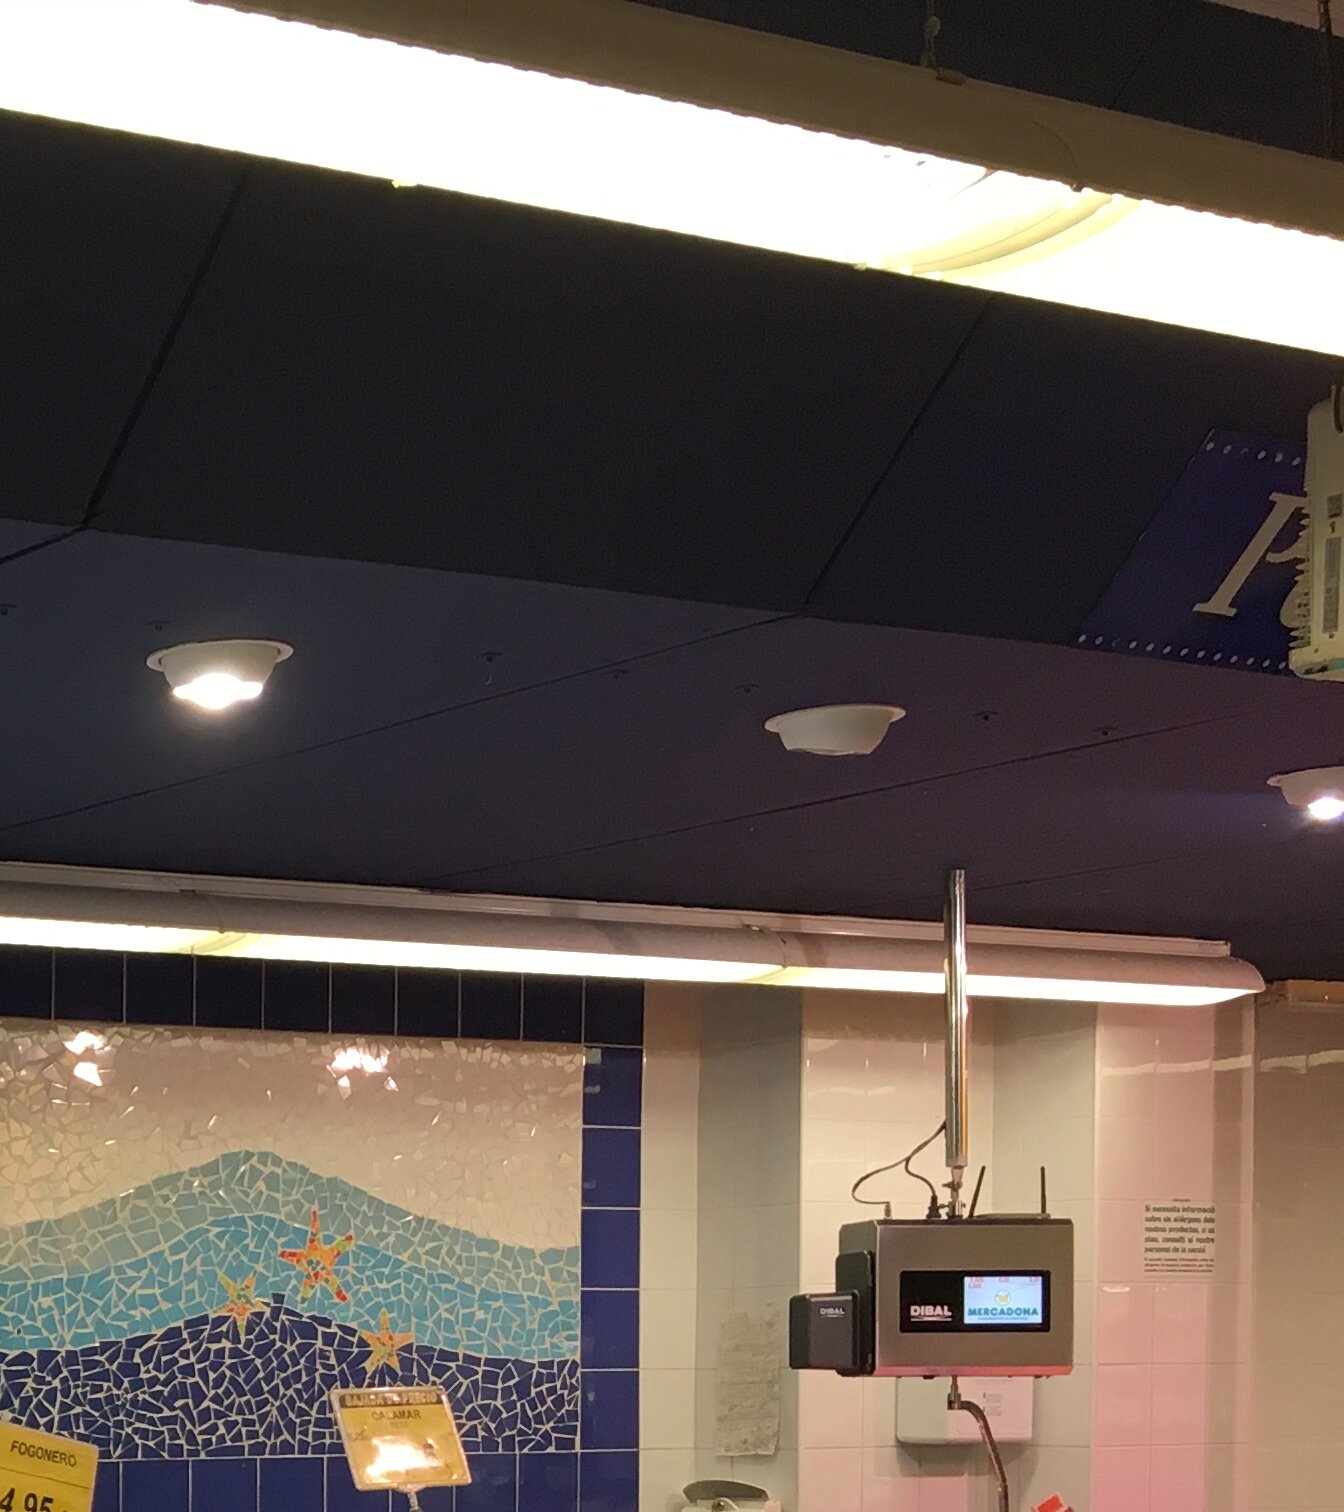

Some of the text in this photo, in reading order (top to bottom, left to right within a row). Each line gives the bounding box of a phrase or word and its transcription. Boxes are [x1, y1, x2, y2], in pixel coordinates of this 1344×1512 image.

[820, 1307, 845, 1315] DIBAL
[909, 1305, 953, 1316] DIBAL
[967, 1307, 1039, 1317] MERCADONA
[371, 1410, 422, 1421] CALAMAR
[10, 1440, 77, 1467] FOGONERO
